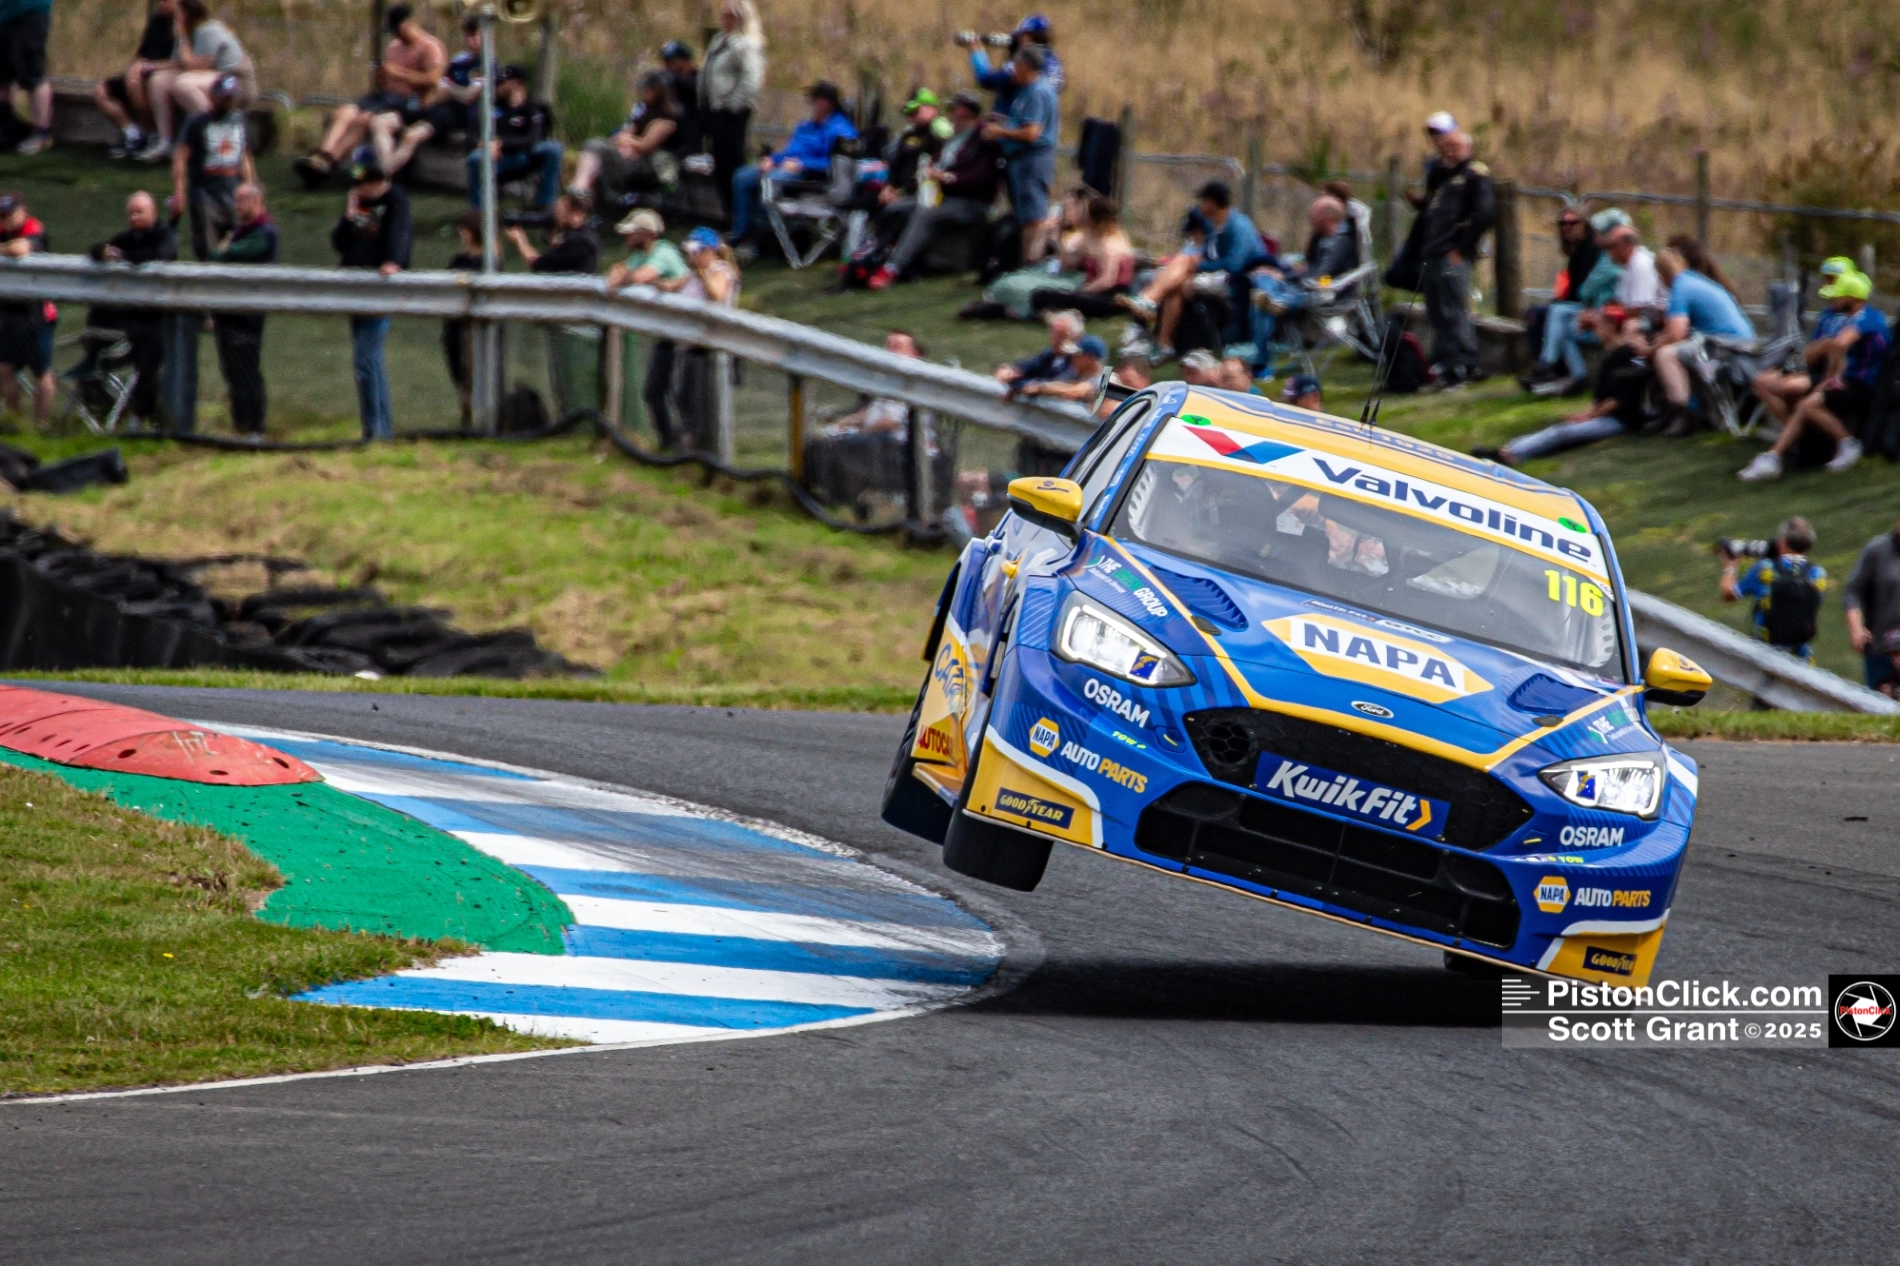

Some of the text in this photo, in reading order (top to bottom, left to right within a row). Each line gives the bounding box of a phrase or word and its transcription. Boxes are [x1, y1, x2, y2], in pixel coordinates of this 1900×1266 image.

[1312, 457, 1591, 563] Valvoline
[1133, 587, 1168, 617] GROUP
[1545, 570, 1603, 617] 116
[1304, 622, 1456, 688] NAPA
[1084, 678, 1150, 728] OSRAM
[1361, 704, 1384, 715] Ford
[1032, 726, 1056, 749] NAPA
[1112, 731, 1137, 746] TOW
[1060, 741, 1148, 793] AUTO PARTS
[1560, 826, 1624, 847] OSRAM
[1540, 886, 1564, 903] NAPA
[1574, 888, 1651, 907] AUTO PARTS
